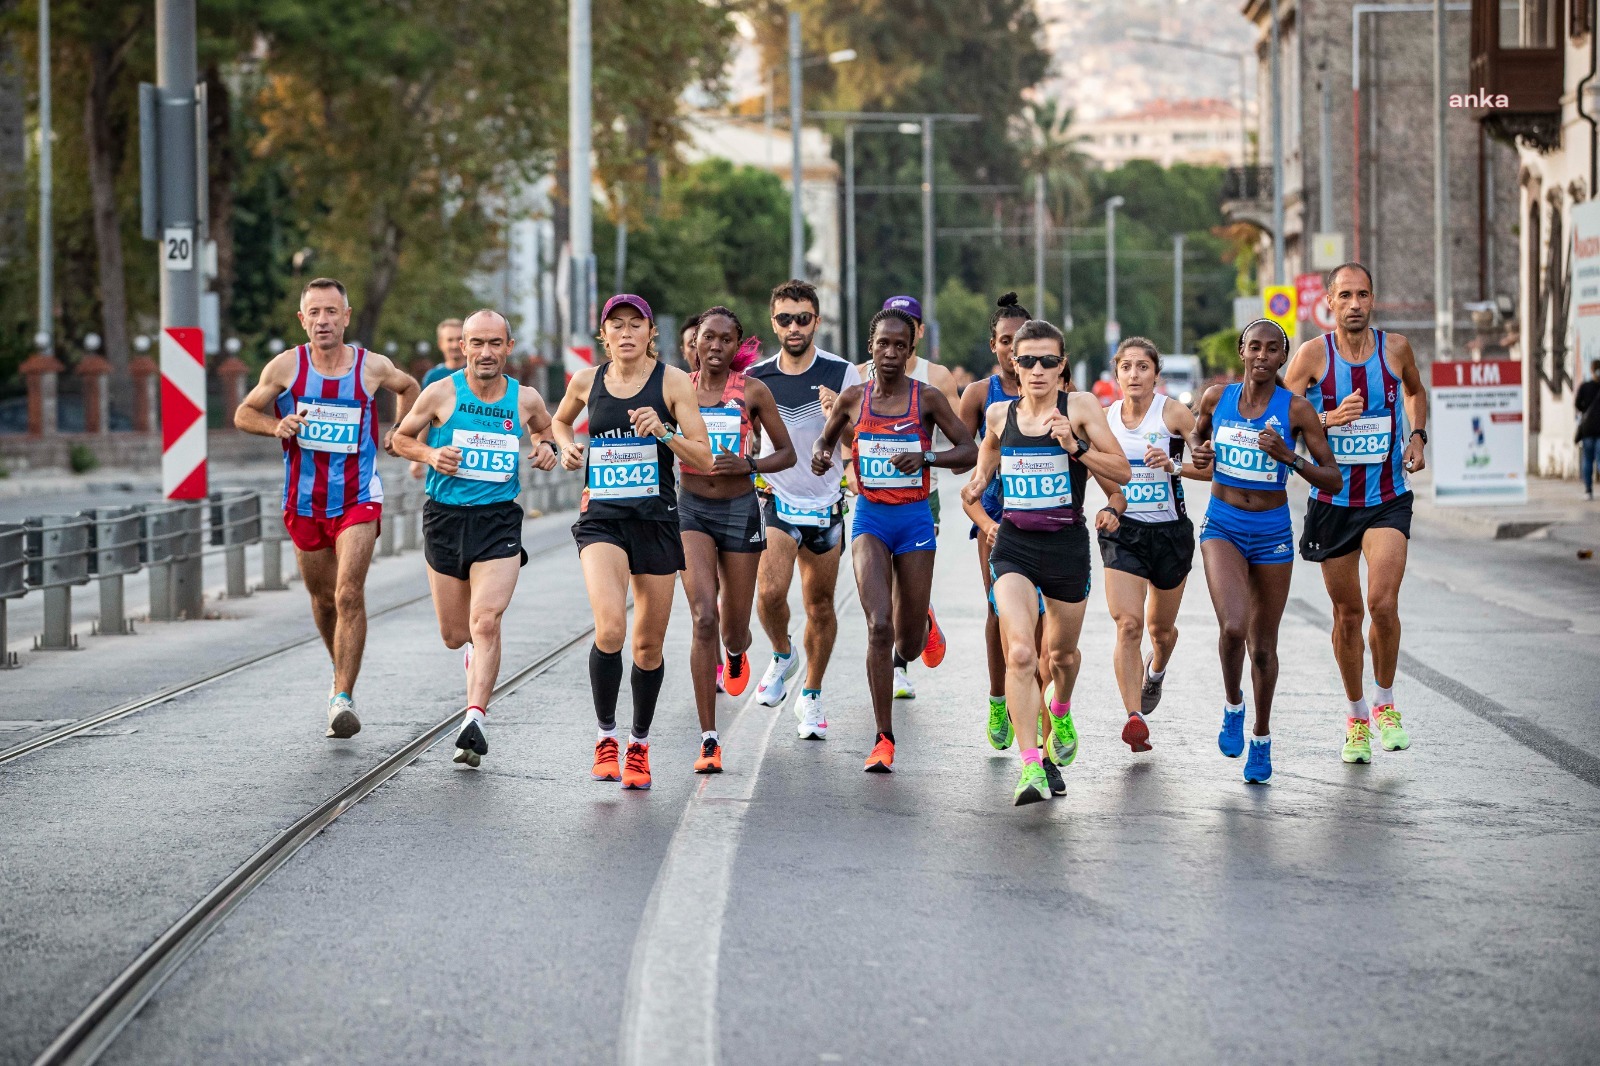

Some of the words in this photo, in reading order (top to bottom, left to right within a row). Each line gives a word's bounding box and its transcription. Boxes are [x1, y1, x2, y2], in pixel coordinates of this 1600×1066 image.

[168, 238, 189, 260] 20
[1455, 363, 1464, 386] 1
[1470, 363, 1501, 385] KM
[458, 402, 514, 419] AĞAOĞLU
[299, 422, 354, 442] 10271
[1331, 434, 1389, 454] 10284
[862, 458, 920, 477] 100
[1219, 445, 1278, 471] 10015
[592, 464, 656, 487] 10342
[1005, 474, 1068, 496] 10182
[1121, 484, 1166, 502] 0095
